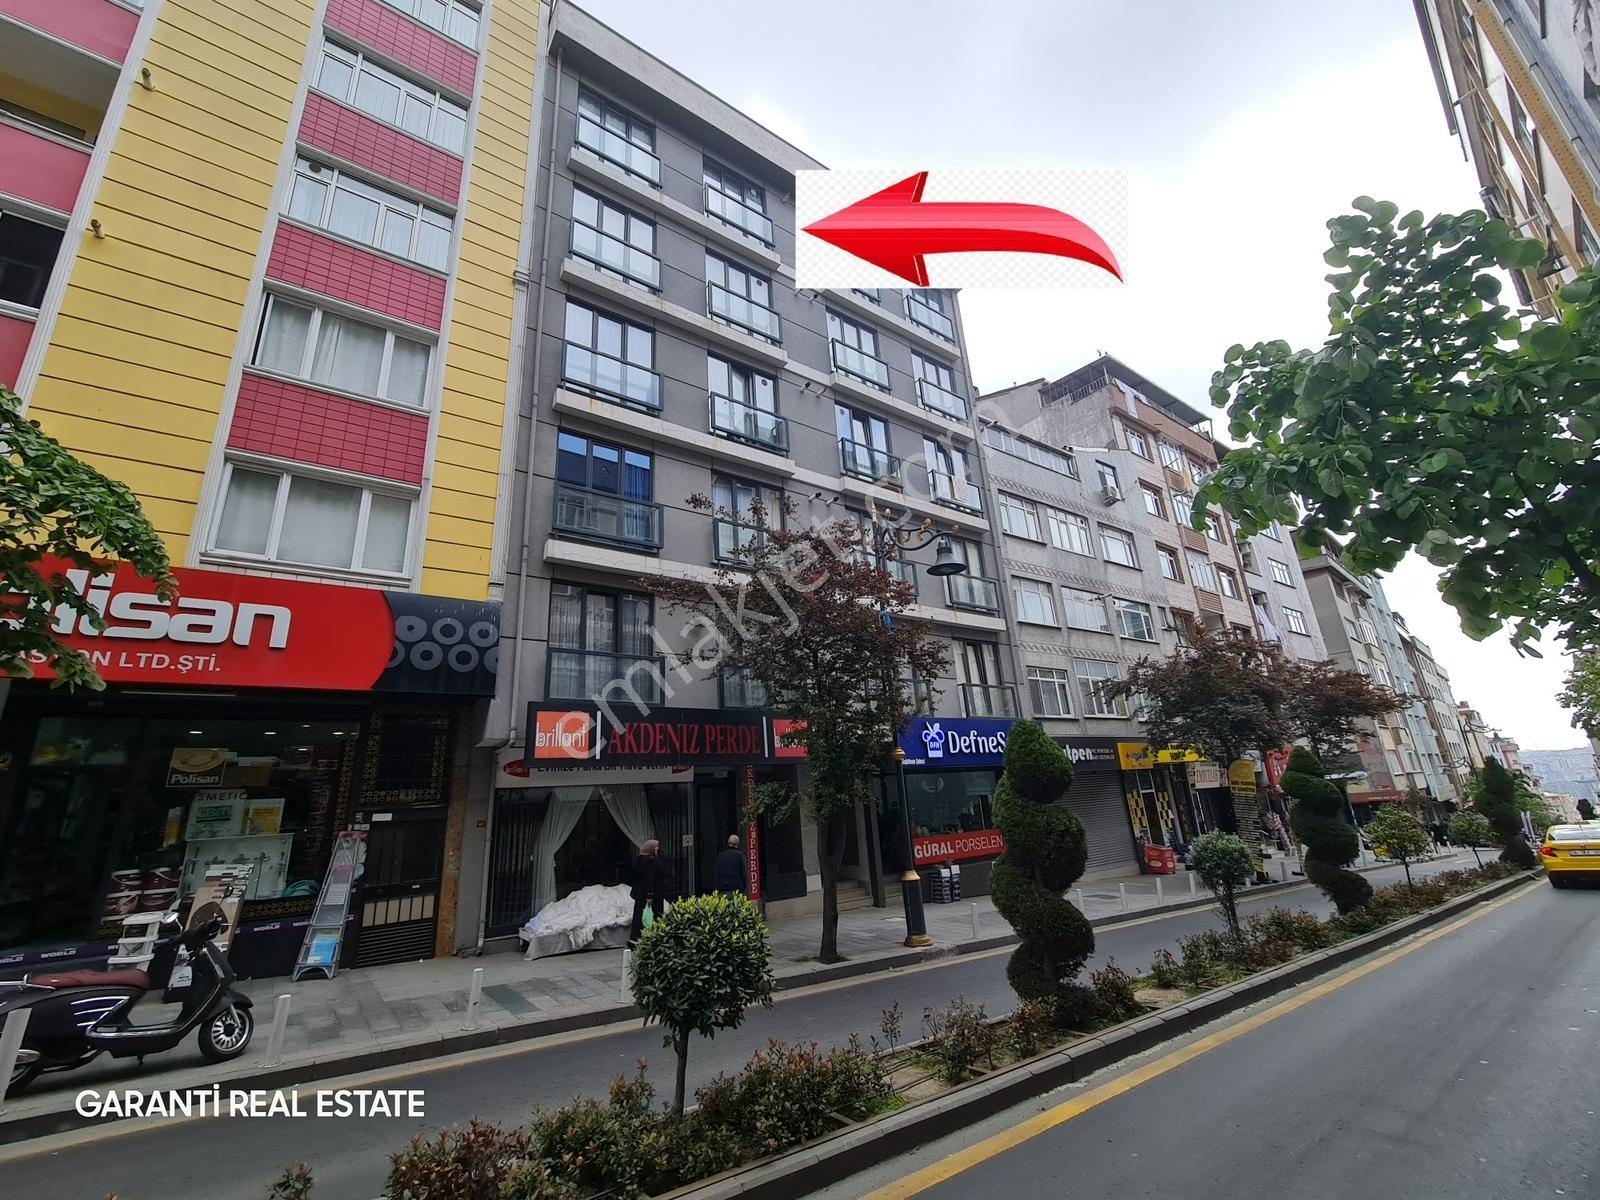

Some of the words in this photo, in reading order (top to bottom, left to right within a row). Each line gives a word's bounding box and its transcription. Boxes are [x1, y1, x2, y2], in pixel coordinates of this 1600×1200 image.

[535, 721, 586, 747] brillant
[703, 723, 761, 754] PERDE
[170, 774, 219, 785] Polisan
[914, 838, 954, 859] GÜRAL
[955, 836, 1004, 853] PORSELEN
[750, 838, 758, 894] PERDE
[40, 949, 77, 959] WORLD
